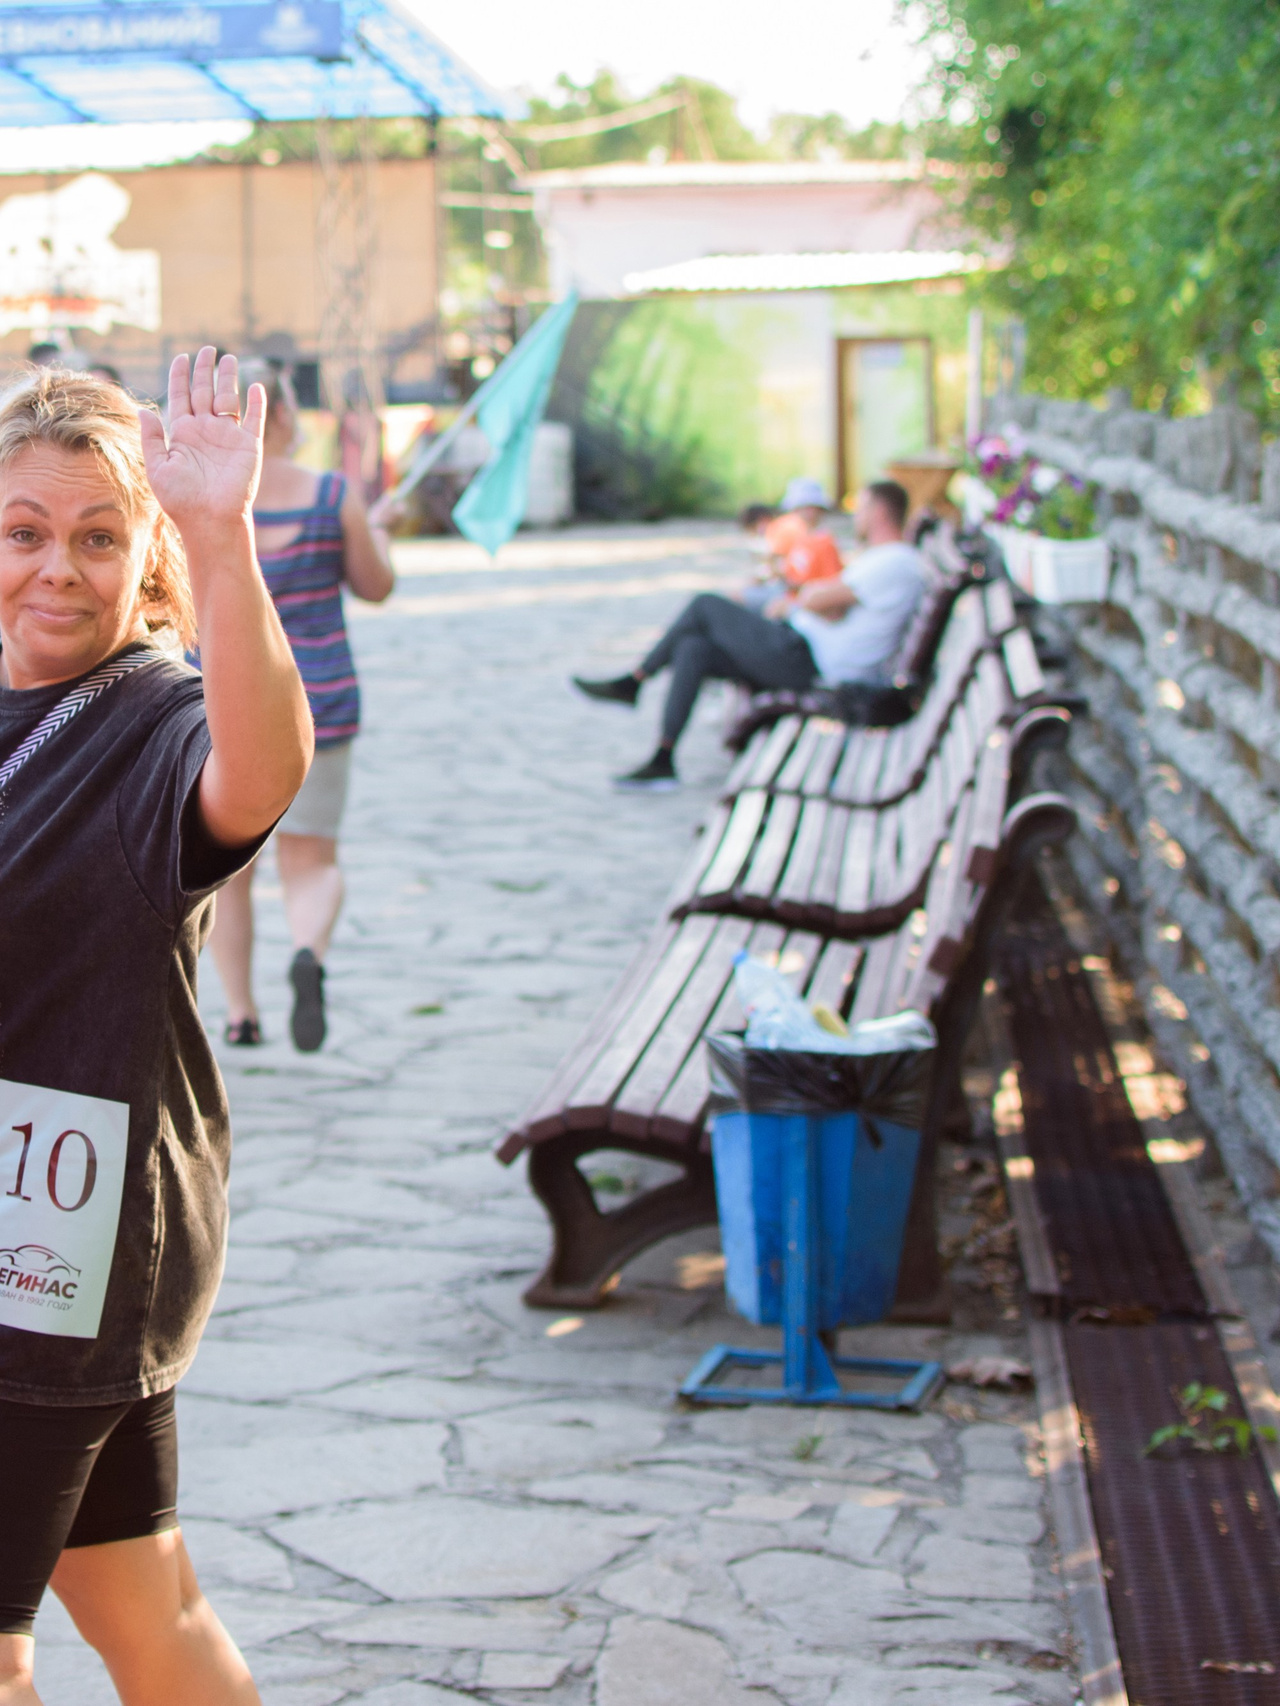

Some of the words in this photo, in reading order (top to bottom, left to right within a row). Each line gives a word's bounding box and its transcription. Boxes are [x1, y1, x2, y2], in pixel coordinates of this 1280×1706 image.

[5, 1121, 98, 1213] 10
[17, 1293, 25, 1303] В
[26, 1295, 46, 1307] 1992
[47, 1300, 74, 1312] ГОДУ
